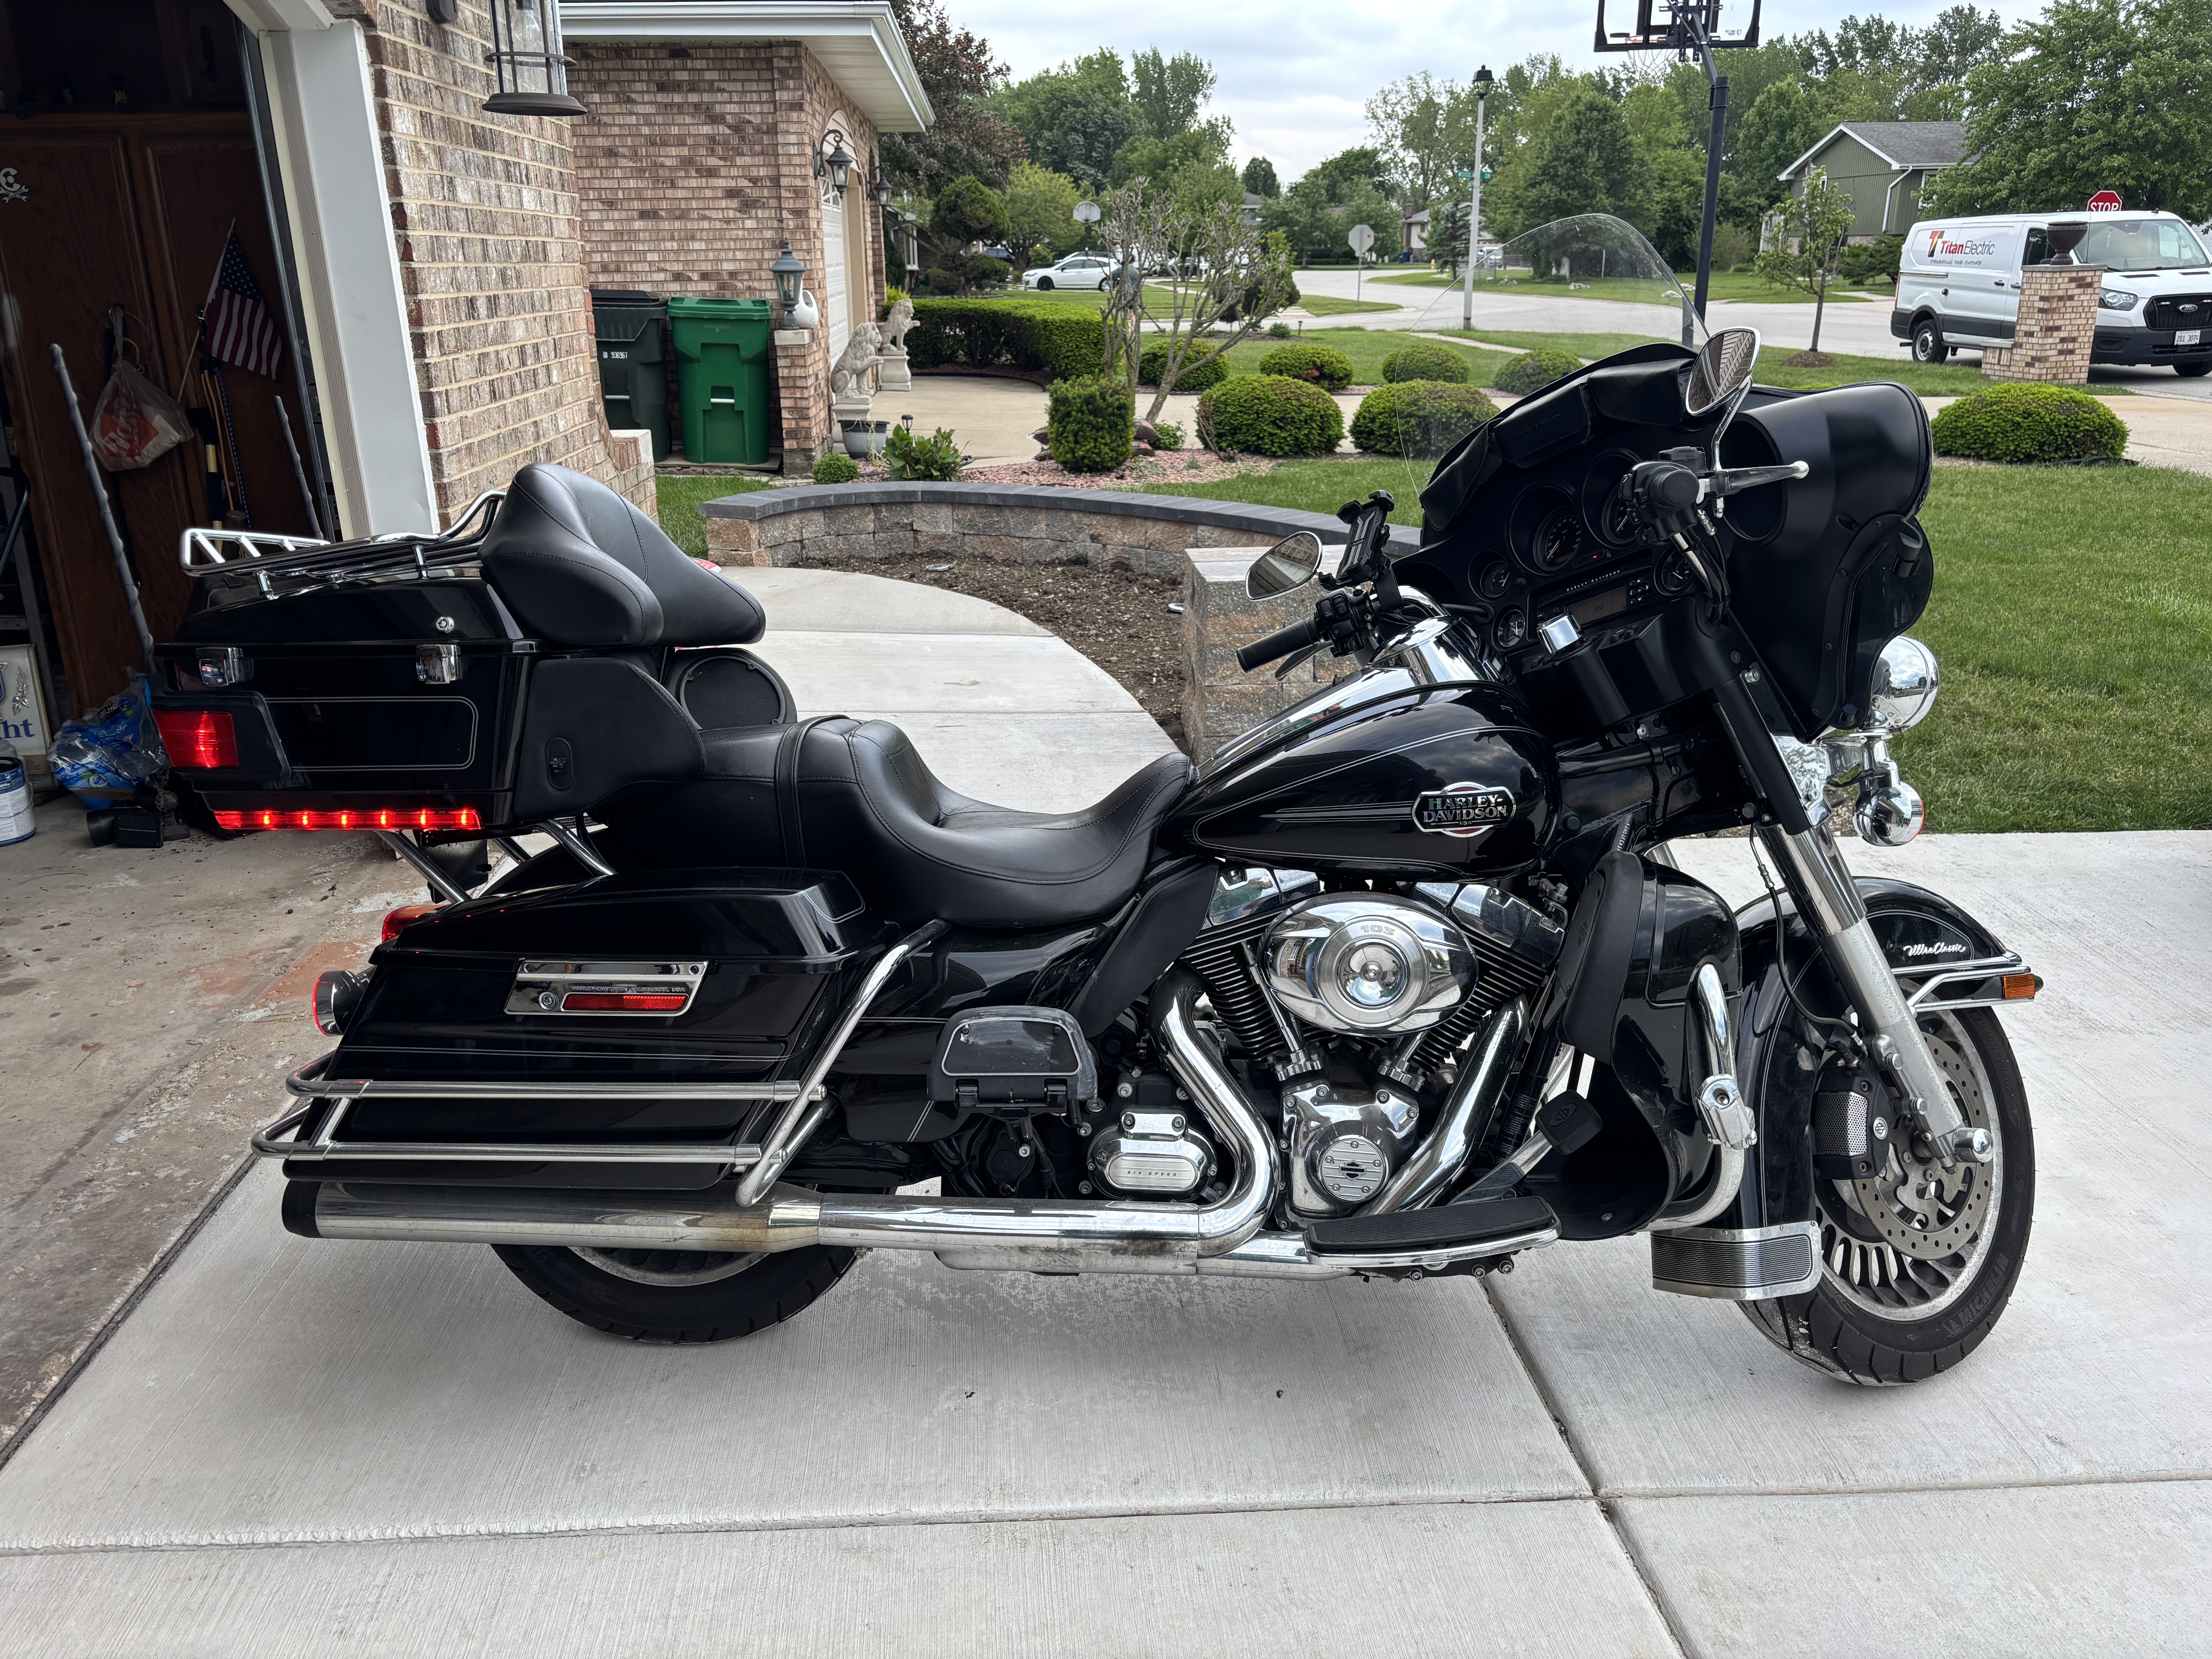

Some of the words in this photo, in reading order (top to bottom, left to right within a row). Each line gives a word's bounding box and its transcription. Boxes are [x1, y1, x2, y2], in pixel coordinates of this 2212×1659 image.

[2089, 202, 2119, 212] STOP
[1428, 794, 1503, 810] HARLEY-
[1423, 805, 1508, 823] DAVIDSON
[1360, 924, 1395, 936] 103
[1958, 1251, 2010, 1326] MICHELIN
